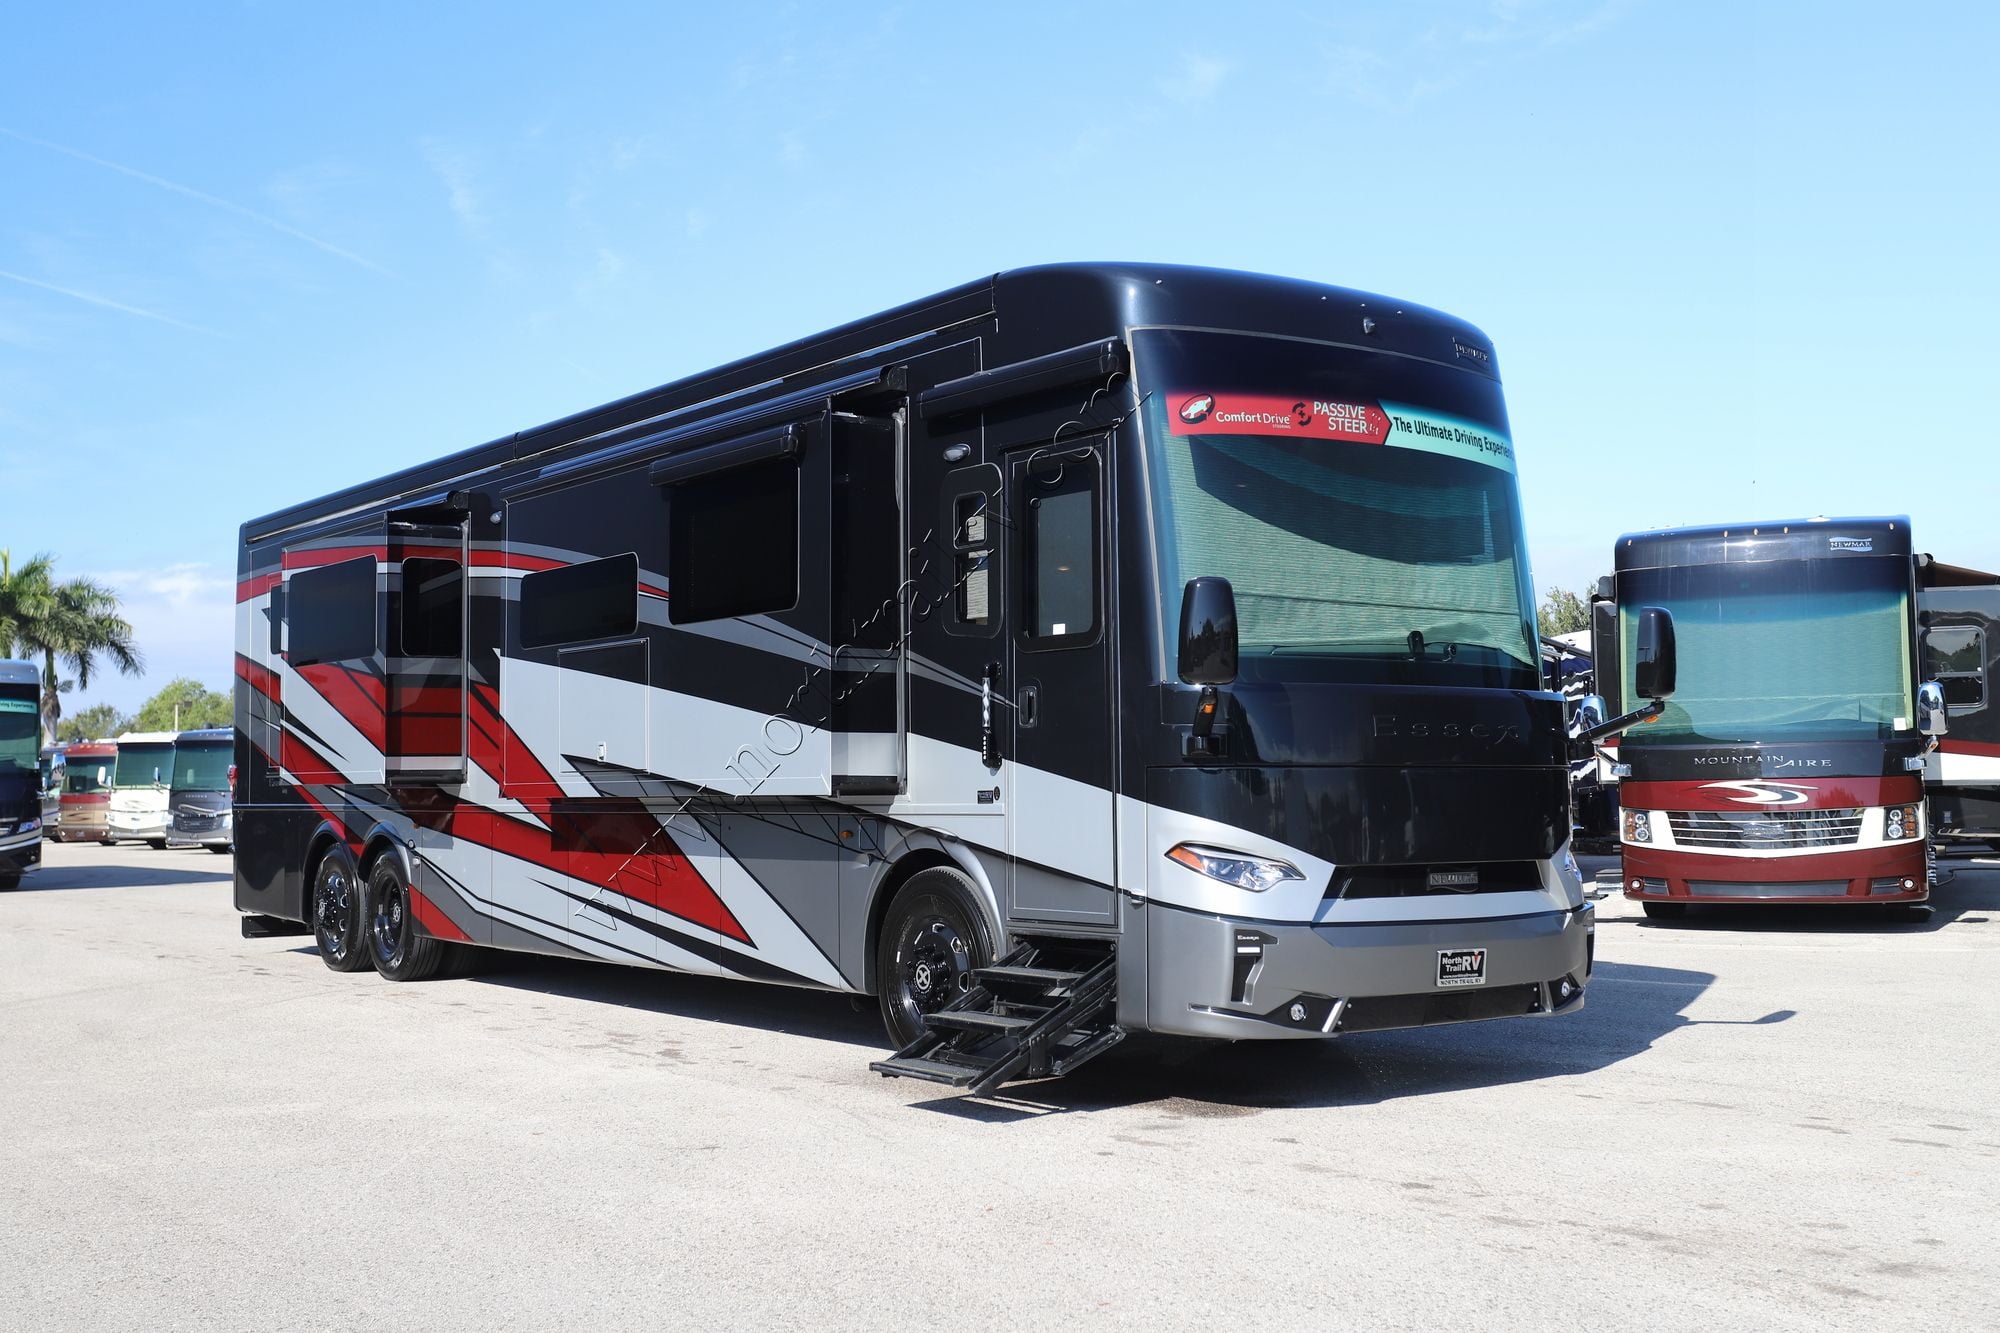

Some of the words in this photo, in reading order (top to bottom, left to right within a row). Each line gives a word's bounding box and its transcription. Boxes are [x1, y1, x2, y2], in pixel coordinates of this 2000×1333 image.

[1215, 411, 1261, 423] Comfort
[1262, 413, 1290, 425] Drive
[1313, 401, 1366, 420] PASSIVE
[1328, 416, 1369, 434] STEER
[1393, 416, 1412, 434] The
[1414, 420, 1454, 441] Ultimate
[1454, 428, 1484, 452] Driving
[1372, 714, 1520, 746] Essex
[1694, 755, 1785, 765] MOUNTAIN
[1774, 759, 1832, 769] AIRE
[1442, 956, 1462, 965] North
[1462, 955, 1482, 971] RV
[1445, 964, 1462, 972] Trail
